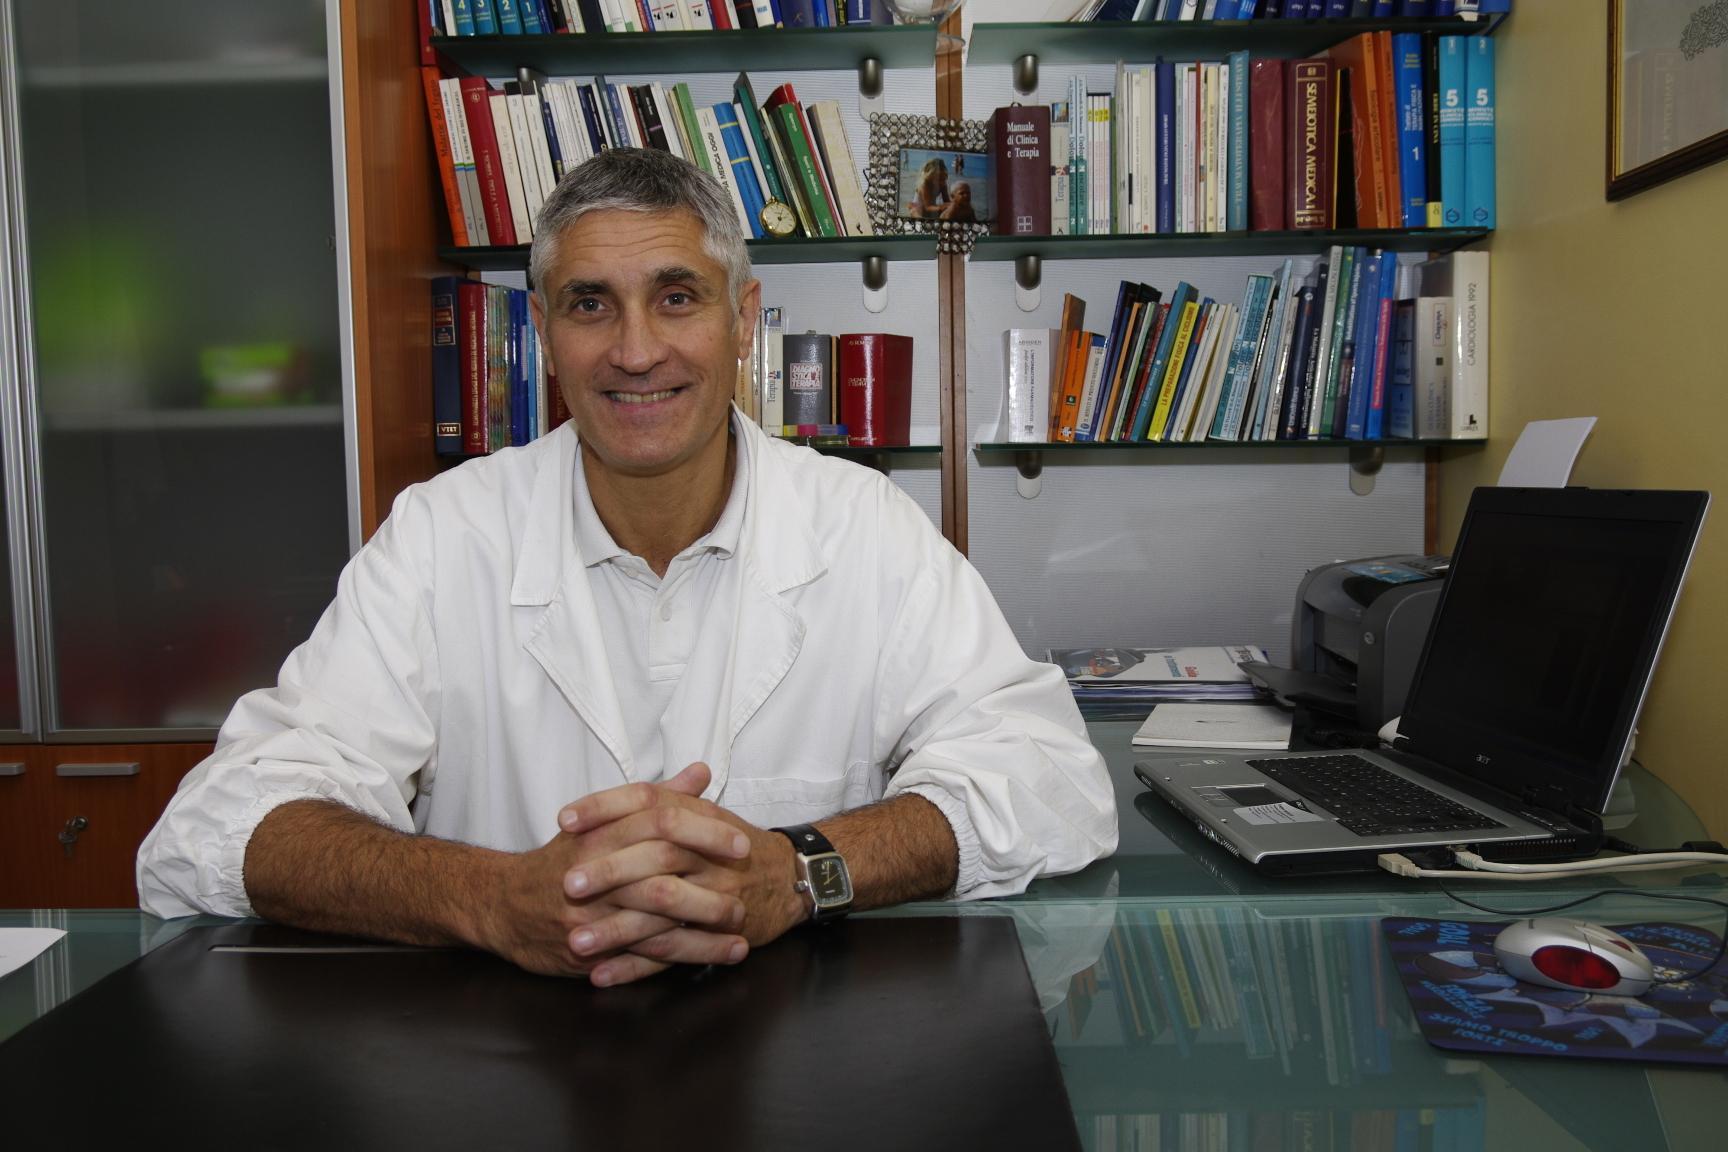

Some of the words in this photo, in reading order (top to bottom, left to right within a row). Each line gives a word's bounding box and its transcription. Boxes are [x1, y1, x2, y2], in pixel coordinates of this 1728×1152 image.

[1445, 88, 1458, 107] 5
[1475, 88, 1488, 106] 5
[1006, 121, 1035, 132] Manuale
[1305, 81, 1316, 153] SEMEIOTICA
[706, 131, 718, 152] OGGI
[1007, 135, 1014, 145] di
[1015, 135, 1039, 145] Clinica
[1014, 147, 1040, 159] Terapia
[1412, 146, 1419, 160] 1
[712, 152, 727, 180] MEDICA
[1304, 154, 1315, 202] MEDICA
[1056, 176, 1067, 202] Terapia
[1467, 281, 1475, 301] 1992
[1467, 303, 1476, 366] CARDIOLOGIA
[1173, 339, 1185, 358] FISICA
[1161, 358, 1180, 397] PREPARAZIONE
[1160, 397, 1168, 405] LA
[1497, 1026, 1569, 1052] TROPPO
